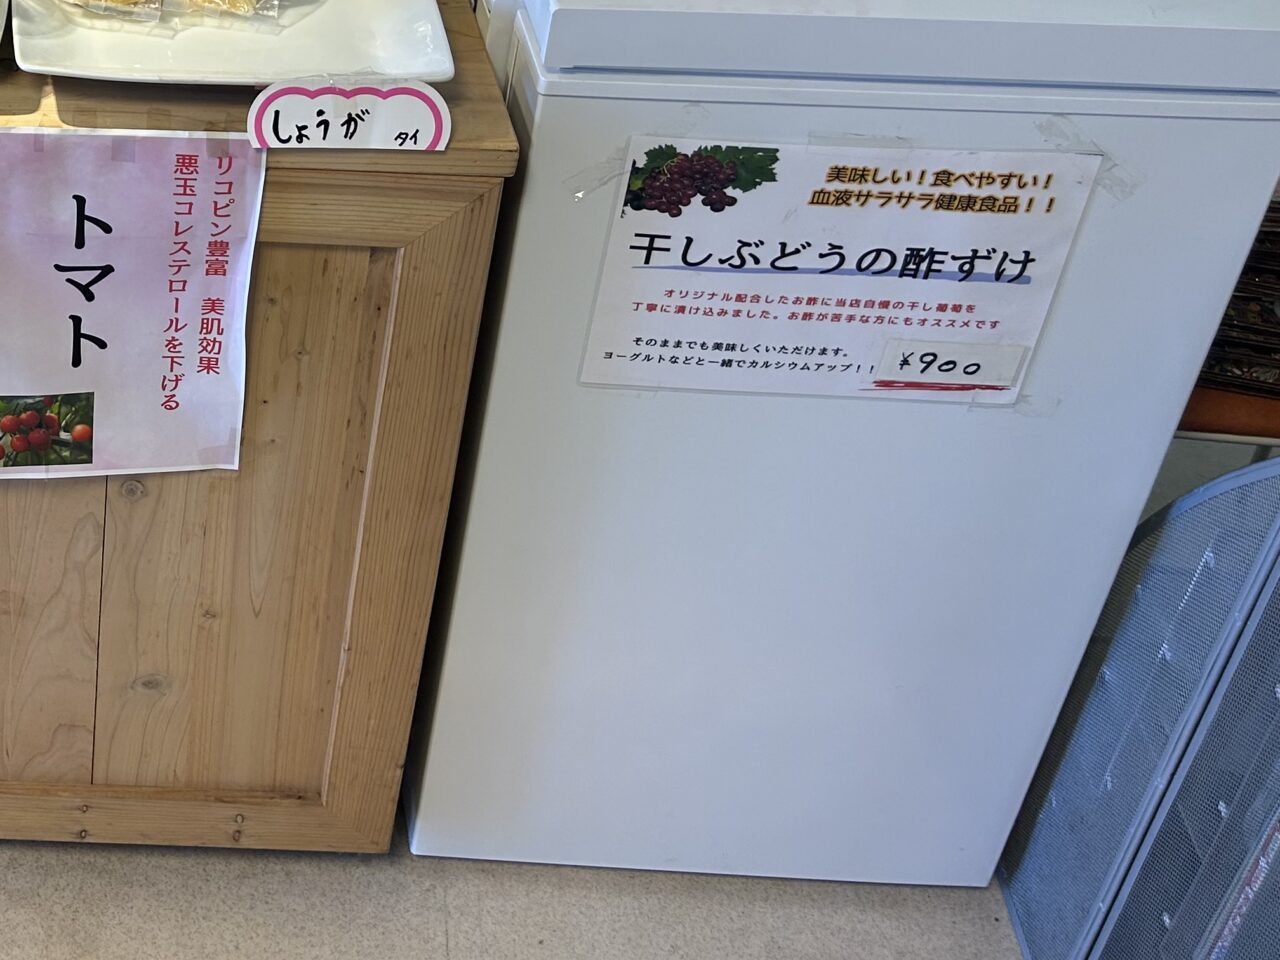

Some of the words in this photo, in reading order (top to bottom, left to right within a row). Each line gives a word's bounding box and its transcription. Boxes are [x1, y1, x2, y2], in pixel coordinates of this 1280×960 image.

[272, 108, 371, 144] しょうが
[394, 129, 419, 146] タイ
[205, 156, 235, 276] リコピン豊富
[53, 194, 116, 369] トマト
[160, 153, 200, 411] 悪玉コレステロールを下げる
[629, 232, 1036, 284] 干しぶどうの酢ずけ
[196, 298, 225, 374] 美肌効果
[633, 337, 848, 357] そのままでも美味しくいただけます。
[899, 352, 981, 376] ¥900
